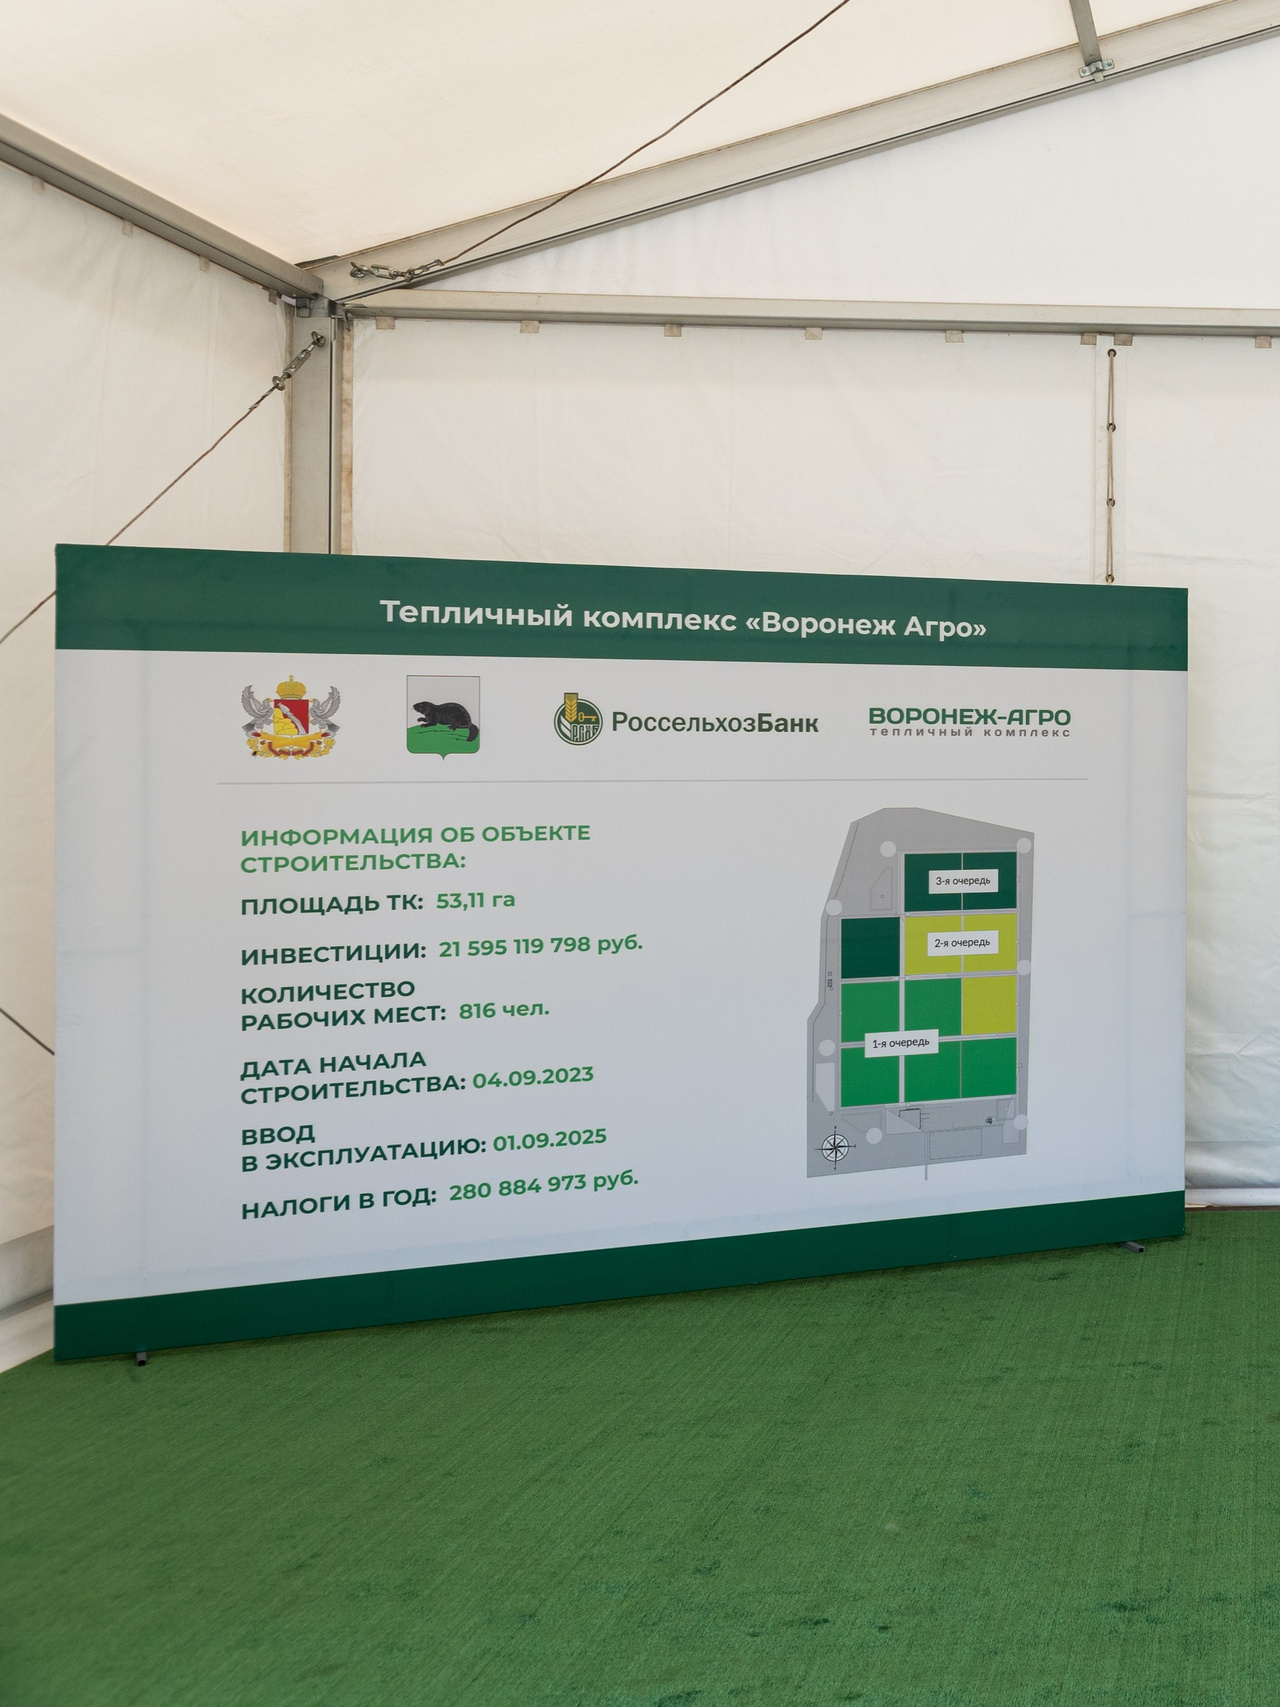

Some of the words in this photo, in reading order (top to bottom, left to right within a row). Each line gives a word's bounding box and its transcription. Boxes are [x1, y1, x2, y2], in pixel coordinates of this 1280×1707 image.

[380, 600, 572, 626] Тепличный
[584, 611, 736, 631] комплекс
[746, 612, 896, 638] «Воронеж
[904, 616, 986, 641] Агро»
[613, 712, 818, 732] РоссельхозБанк
[870, 708, 1071, 726] ВОРОНЕЖ-АГРО
[870, 727, 972, 736] тепличный
[984, 729, 1069, 737] комплекс
[242, 828, 432, 846] ИНФОРМАЦИЯ
[441, 827, 474, 842] ОБ
[482, 825, 590, 842] ОБЪЕКТЕ
[241, 853, 465, 873] СТРОИТЕЛЬСТВА:
[936, 877, 950, 885] 3-я
[953, 878, 990, 886] очередь
[242, 896, 379, 915] ПЛОЩАДЬ
[387, 894, 423, 910] ТК:
[437, 893, 483, 911] 53,11
[493, 895, 515, 907] га
[242, 943, 426, 965] ИНВЕСТИЦИИ:
[439, 942, 459, 957] 21
[468, 940, 507, 956] 595
[514, 938, 543, 954] 119
[551, 937, 590, 952] 798
[598, 934, 642, 954] руб.
[935, 939, 948, 947] 2-я
[951, 939, 990, 948] очередь
[242, 981, 415, 1004] КОЛИЧЕСТВО
[242, 1009, 365, 1031] РАБОЧИХ
[375, 1006, 445, 1024] МЕСТ:
[460, 1003, 496, 1019] 816
[503, 1004, 549, 1016] чел.
[873, 1040, 886, 1048] 1-я
[889, 1039, 929, 1048] очередь
[240, 1059, 311, 1081] ДАТА
[320, 1052, 426, 1073] НАЧАЛА
[240, 1074, 466, 1104] СТРОИТЕЛЬСТВА:
[473, 1067, 593, 1088] 04.09.2023
[242, 1125, 315, 1145] ВВОД
[242, 1156, 258, 1172] В
[265, 1137, 487, 1171] ЭКСПЛУАТАЦИЮ:
[493, 1128, 606, 1151] 01.09.2025
[243, 1195, 349, 1219] НАЛОГИ
[360, 1193, 374, 1209] В
[383, 1188, 436, 1207] ГОД:
[450, 1183, 491, 1200] 280
[499, 1178, 541, 1196] 884
[548, 1174, 586, 1192] 973
[594, 1169, 638, 1191] руб.
